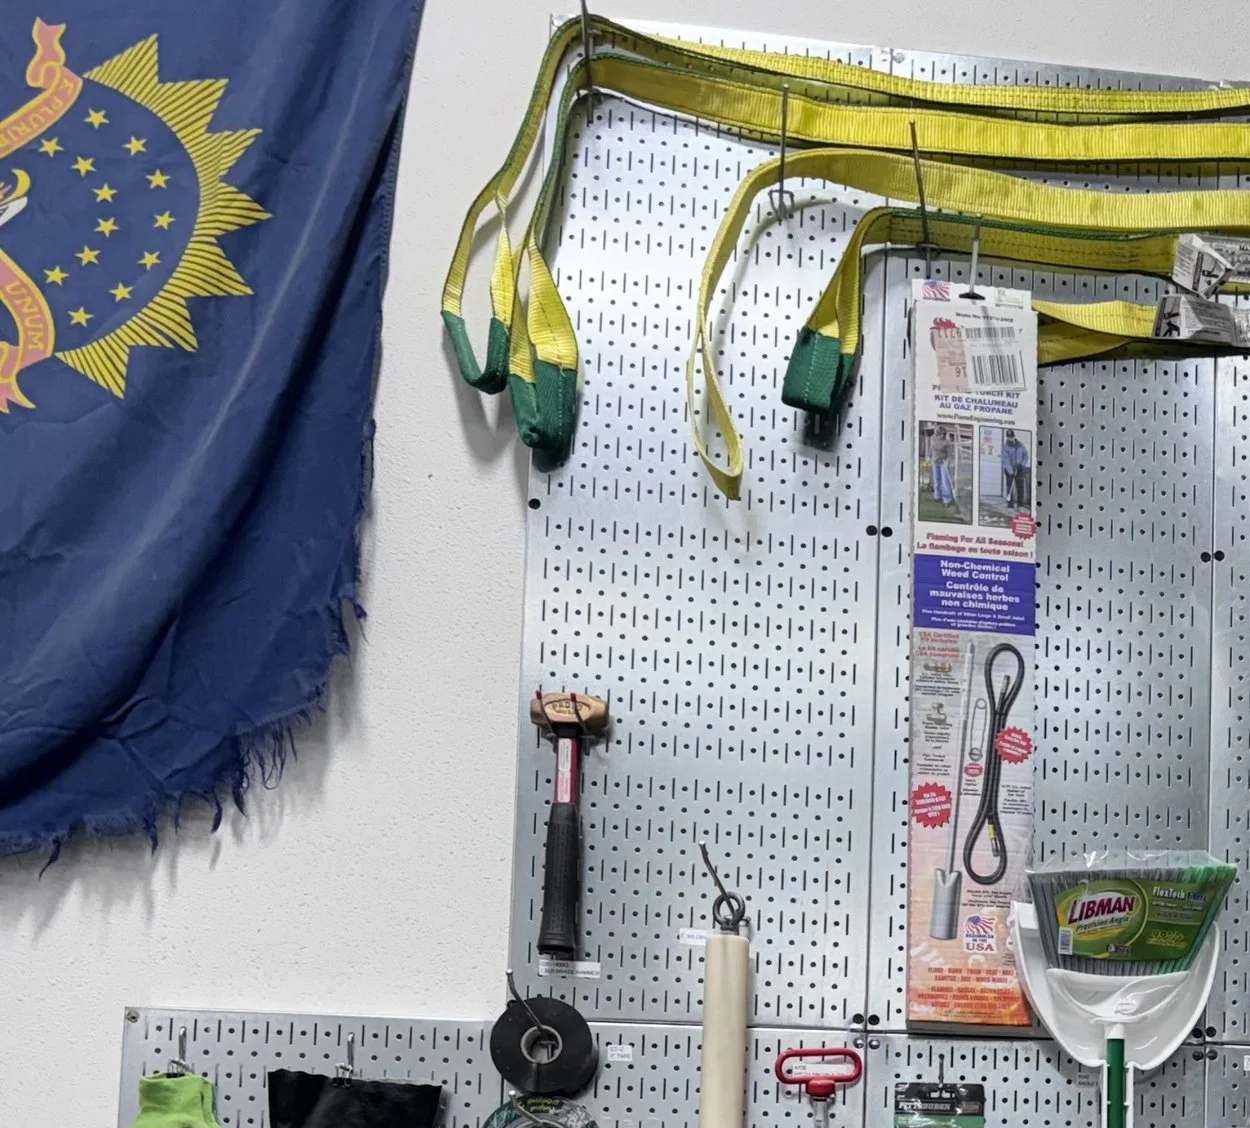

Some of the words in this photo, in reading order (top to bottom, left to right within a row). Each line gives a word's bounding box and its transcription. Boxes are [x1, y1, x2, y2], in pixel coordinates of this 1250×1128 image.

[6, 280, 44, 350] UNUM
[934, 394, 949, 402] KIT
[952, 395, 962, 403] DE
[965, 397, 1018, 409] CHALUMEAU
[1006, 392, 1020, 400] KIT
[954, 403, 971, 412] GAZ
[974, 405, 1013, 415] PROPANE
[926, 532, 959, 543] Flaming
[961, 535, 973, 543] For
[975, 536, 986, 544] All
[929, 542, 966, 553] flambage
[980, 547, 1001, 555] toute
[1003, 549, 1028, 557] saison
[940, 560, 1010, 573] Non-Chemical
[941, 569, 969, 578] Weed
[972, 571, 1009, 581] Control
[946, 581, 989, 592] Contrôle
[992, 585, 1004, 593] de
[929, 589, 983, 600] mauvaises
[986, 592, 1020, 603] herbes
[963, 600, 1008, 611] chimique
[1153, 886, 1185, 899] FlexTech
[1068, 896, 1135, 925] LIBMAN
[1076, 920, 1110, 932] Precision
[1110, 915, 1130, 925] Angle
[966, 943, 994, 952] USA
